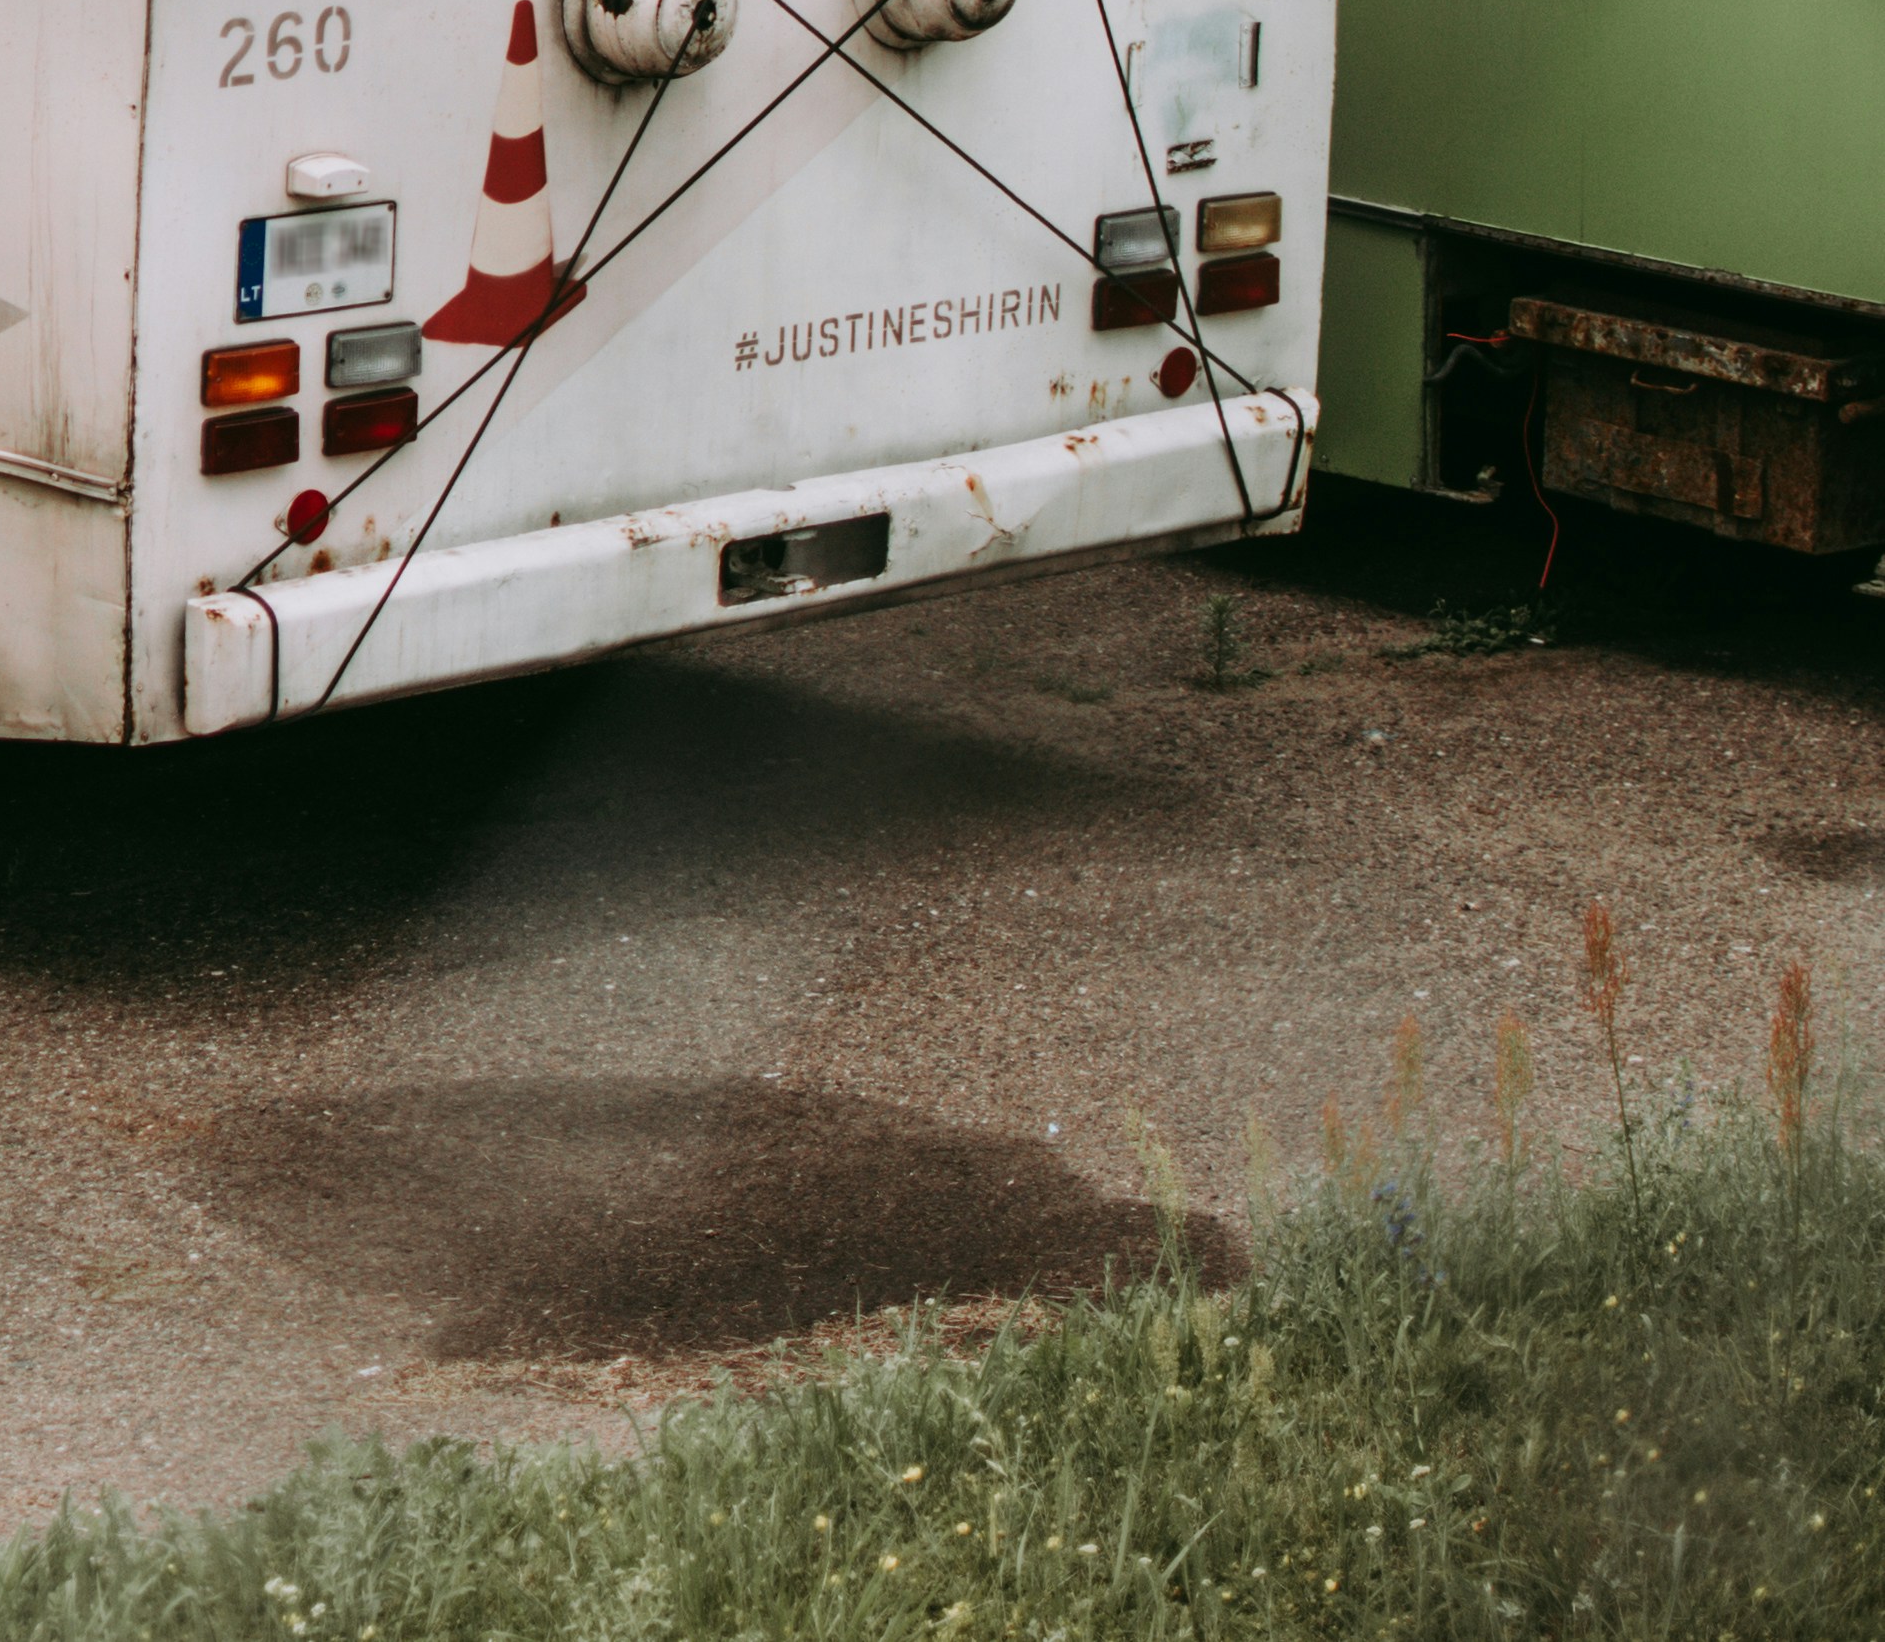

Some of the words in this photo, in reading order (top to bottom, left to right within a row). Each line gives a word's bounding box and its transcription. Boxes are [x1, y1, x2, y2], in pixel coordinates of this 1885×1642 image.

[218, 6, 351, 89] 260
[240, 284, 262, 303] LT
[734, 282, 1061, 371] #JUSTINESHIRIN
